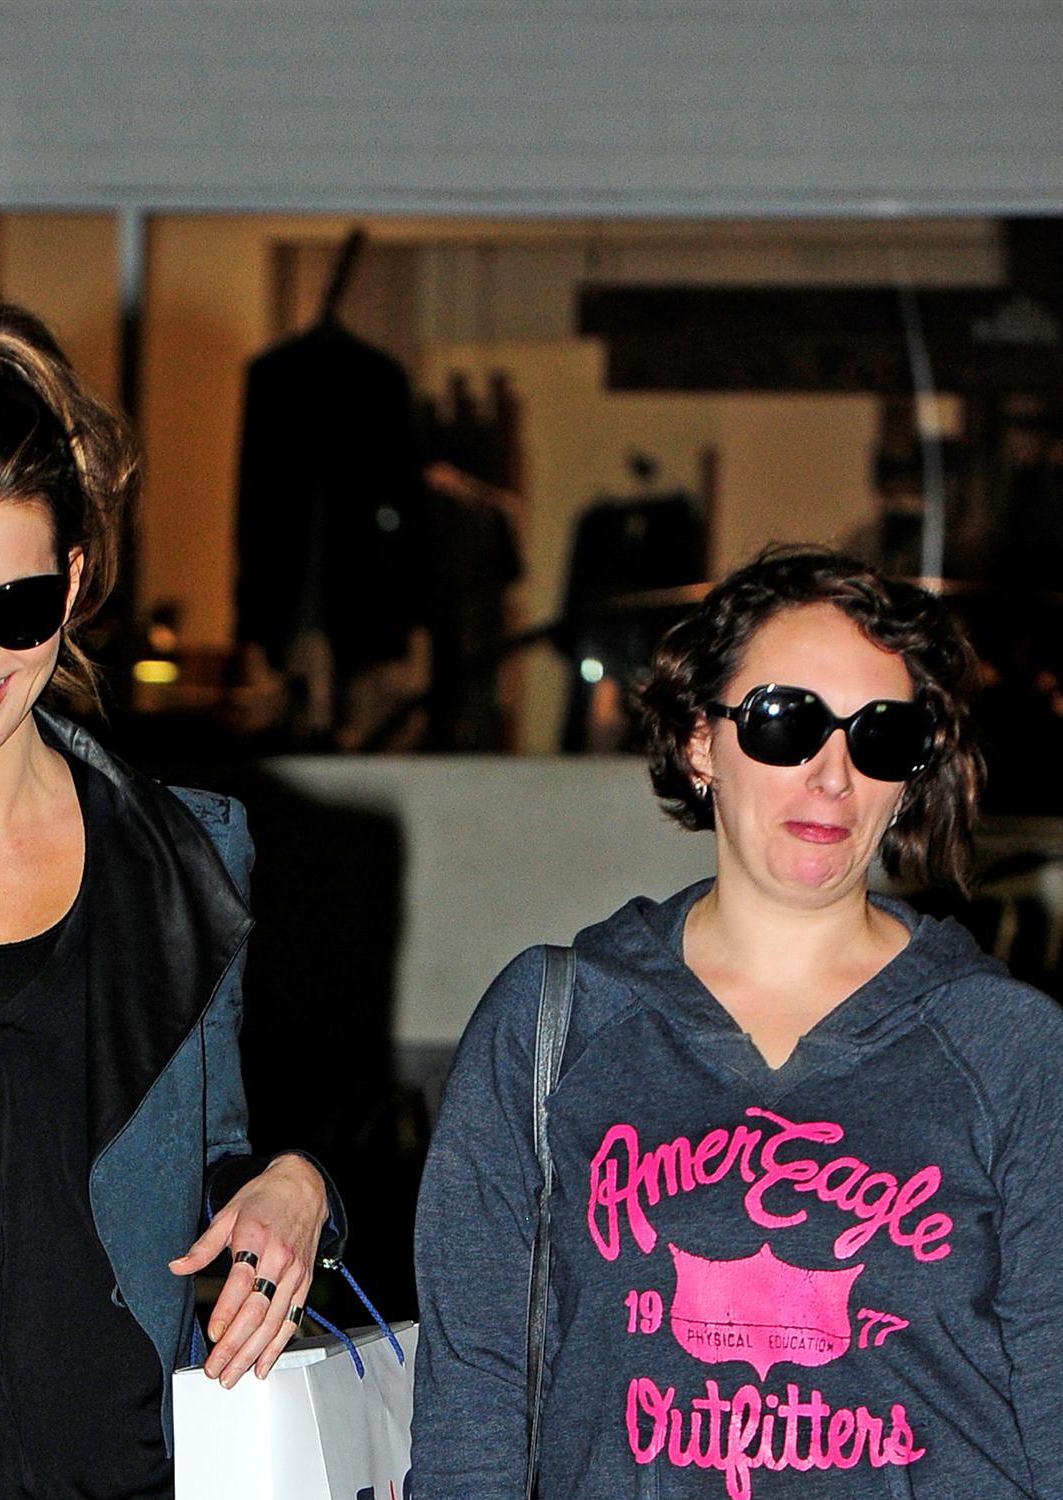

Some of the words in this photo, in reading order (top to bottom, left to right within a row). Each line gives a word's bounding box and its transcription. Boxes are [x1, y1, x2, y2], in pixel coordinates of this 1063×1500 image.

[624, 1289, 664, 1334] 19
[855, 1308, 910, 1349] 77
[687, 1329, 754, 1349] PHYSICAL
[768, 1335, 834, 1353] EDUCATION
